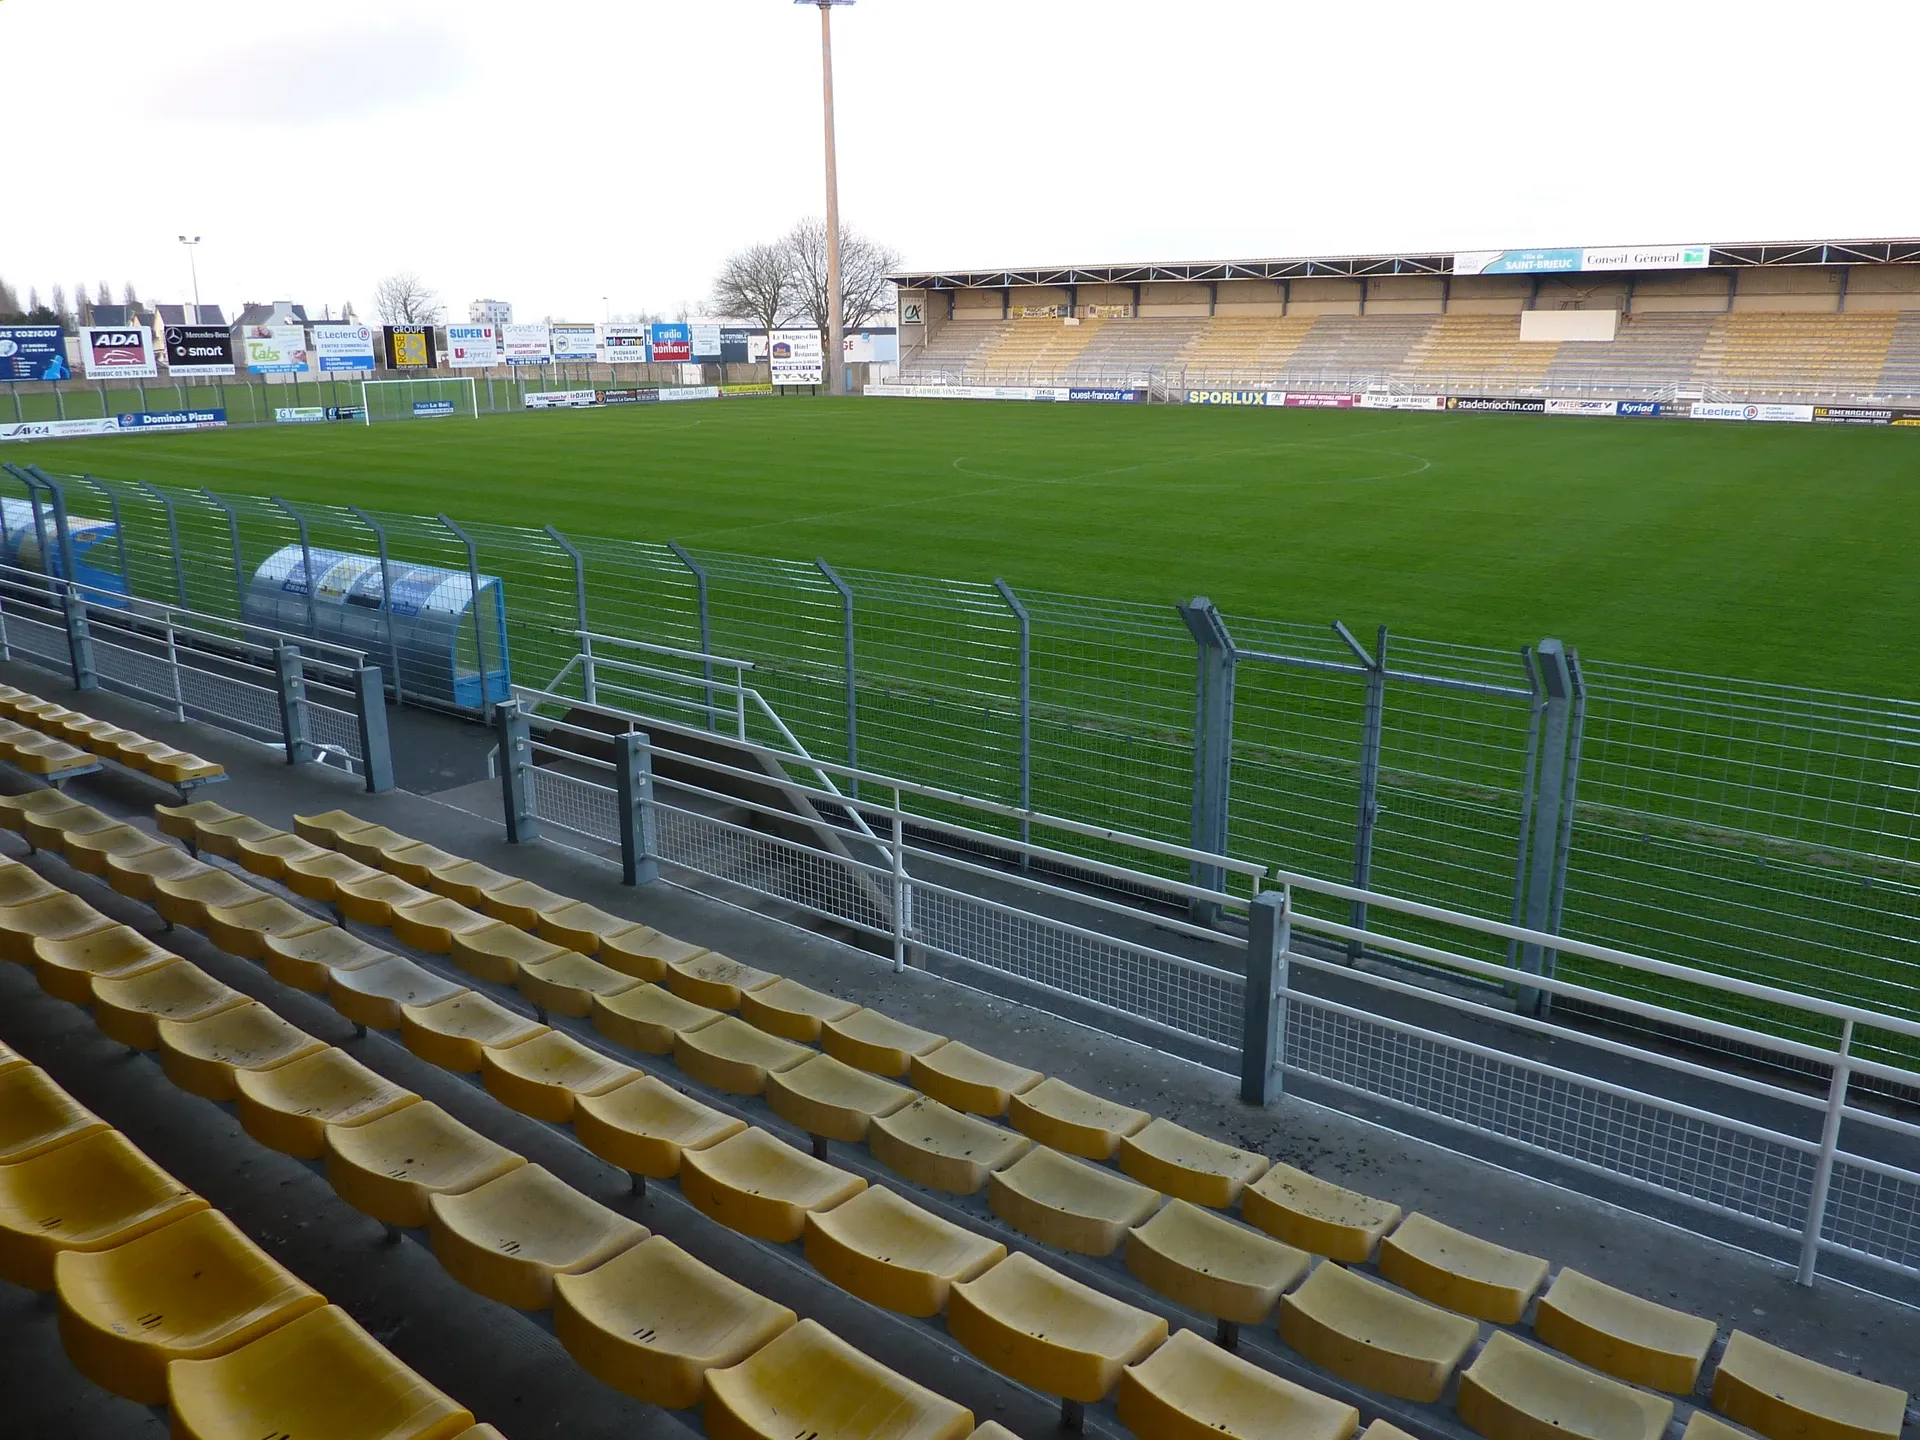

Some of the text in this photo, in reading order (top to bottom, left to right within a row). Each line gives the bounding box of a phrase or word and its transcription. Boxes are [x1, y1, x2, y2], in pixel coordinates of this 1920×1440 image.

[1587, 253, 1680, 265] Conseil Général
[1504, 259, 1573, 270] SAINT-BRIEUC
[392, 325, 425, 334] GROUPE
[450, 328, 491, 338] SUPER U
[611, 326, 638, 335] imprimerie
[659, 329, 682, 339] radio
[95, 334, 140, 346] ADA
[185, 331, 230, 339] Mercedes-Benz
[317, 331, 357, 339] E.Leclerc
[189, 346, 223, 356] smart
[396, 335, 407, 363] ROSE
[653, 340, 689, 353] bonheur
[248, 343, 280, 361] Tabs
[454, 348, 464, 358] U
[1071, 391, 1121, 400] ouest-france.fr
[1189, 391, 1264, 404] SPORLUX
[1458, 399, 1544, 411] stadebriochin.com
[1621, 403, 1655, 413] Kyriad
[1693, 407, 1741, 416] E.Leclerc
[1828, 409, 1892, 417] AMENAGEMENTS
[143, 412, 214, 424] Domino's Pizza
